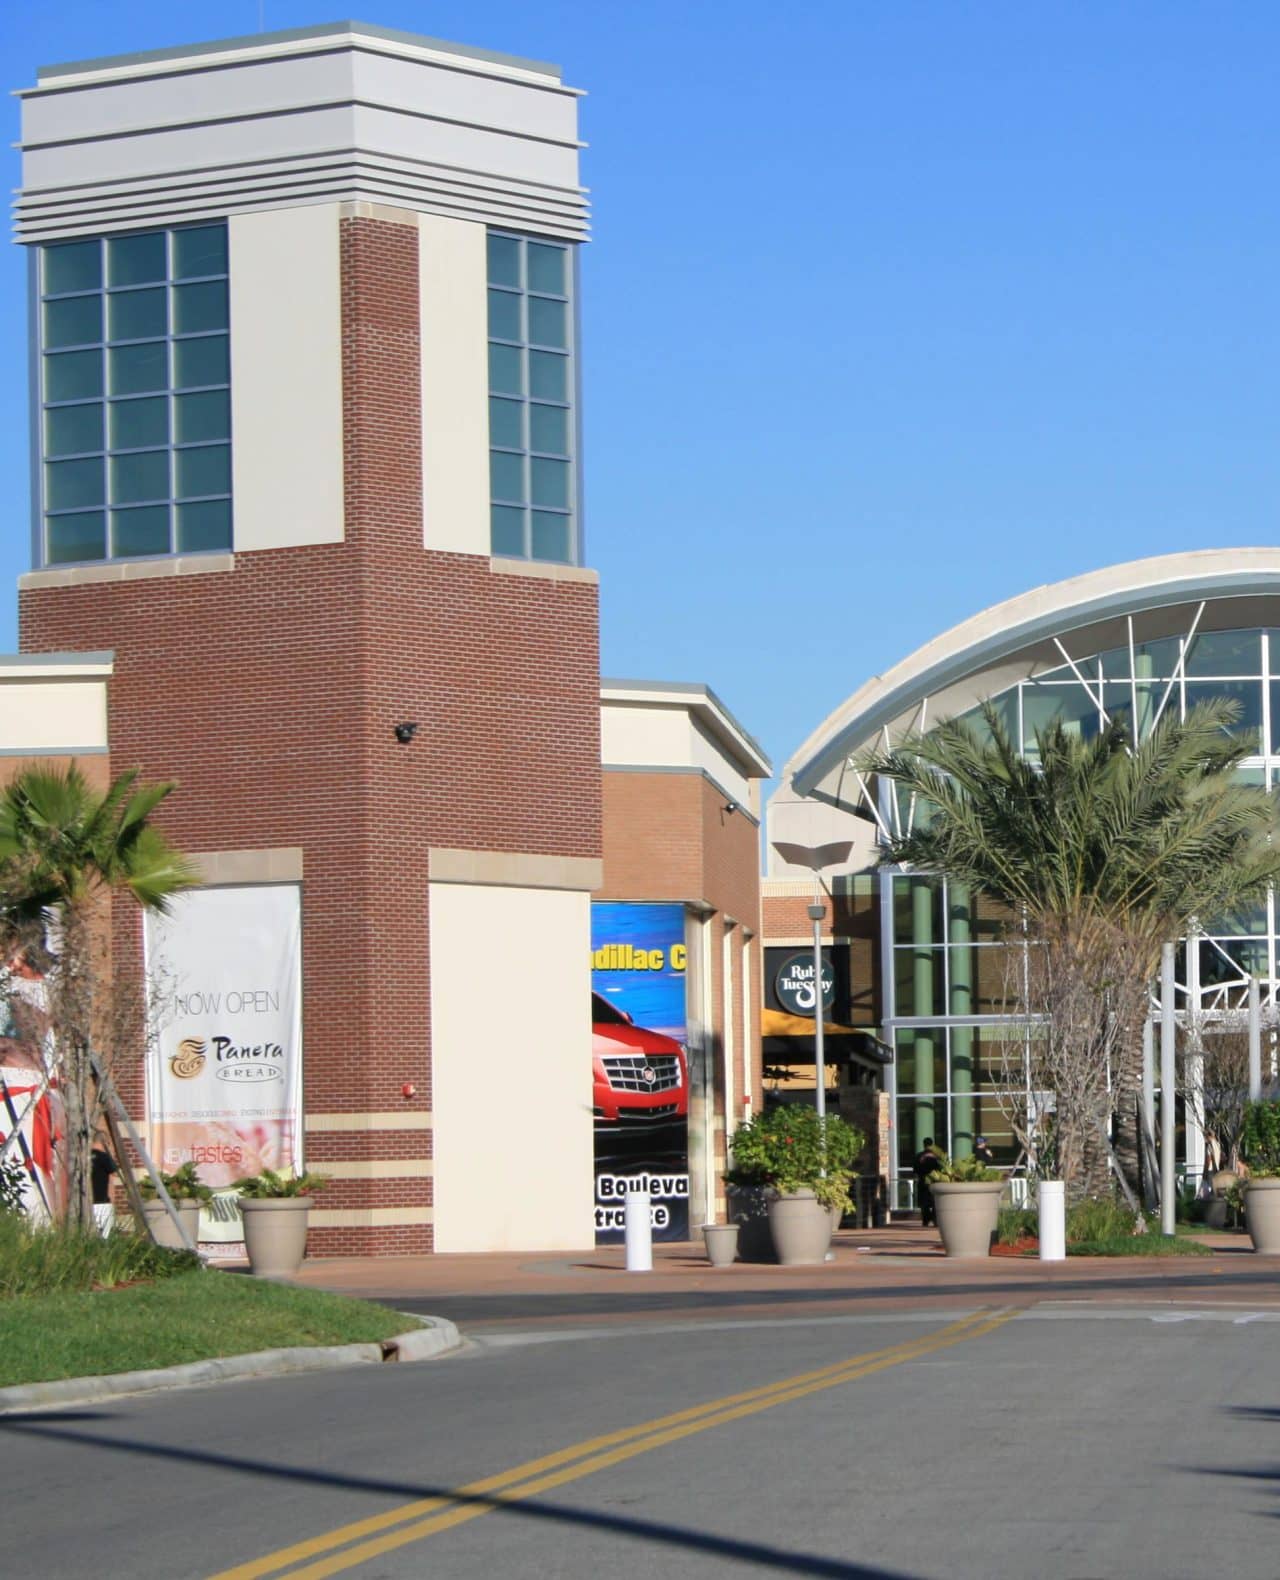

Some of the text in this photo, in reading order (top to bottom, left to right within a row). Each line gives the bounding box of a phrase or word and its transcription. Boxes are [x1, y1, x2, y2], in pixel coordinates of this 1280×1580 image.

[591, 944, 664, 970] dillac
[174, 990, 280, 1015] NOW OPEN
[780, 978, 833, 1008] Tuesay
[211, 1036, 283, 1061] Panera
[223, 1068, 277, 1078] BREAD
[191, 1142, 242, 1164] tastes
[598, 1172, 689, 1199] Bouleva
[594, 1203, 669, 1230] trae
